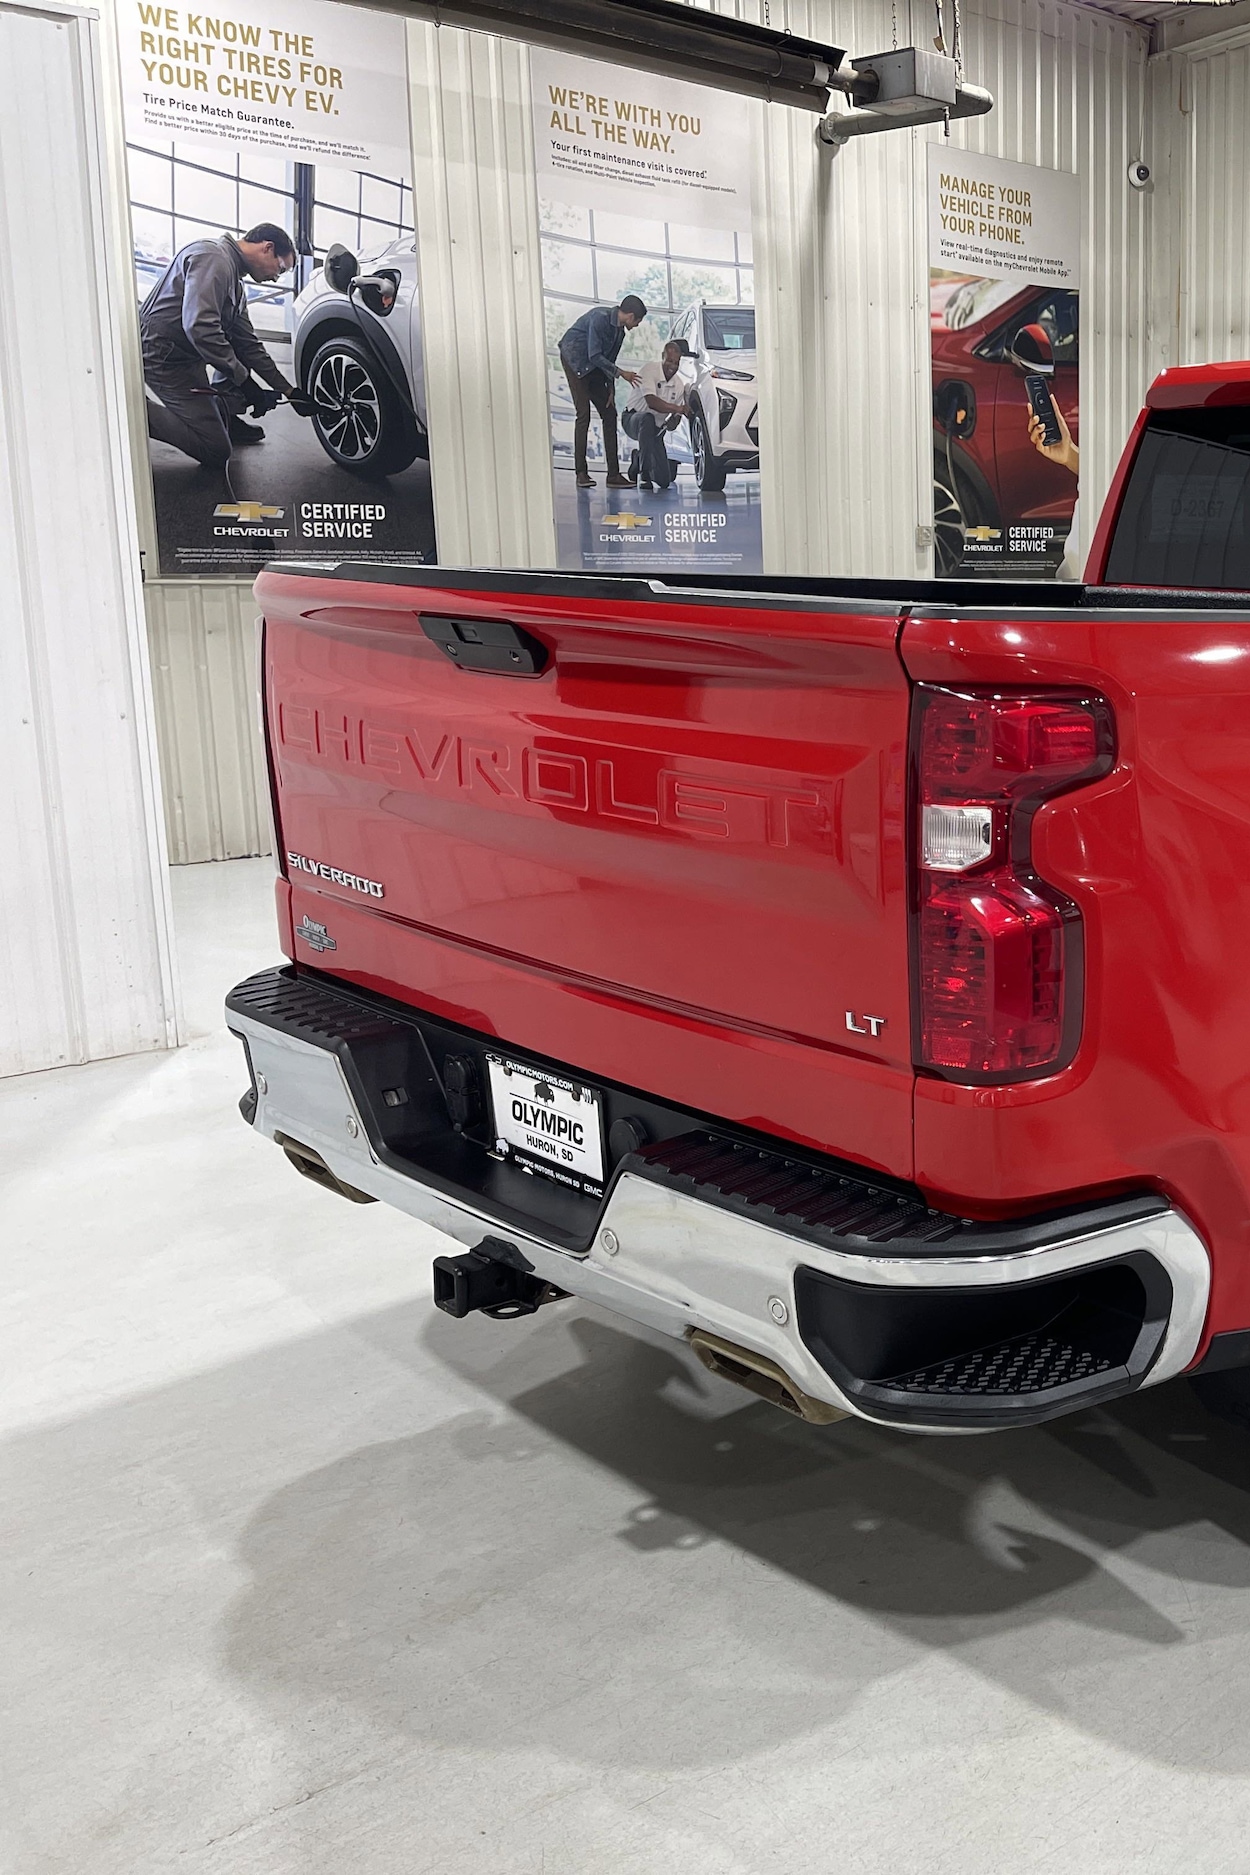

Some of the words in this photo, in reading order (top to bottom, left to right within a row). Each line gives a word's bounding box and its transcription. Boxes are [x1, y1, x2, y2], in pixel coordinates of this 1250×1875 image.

[137, 2, 179, 31] WE
[188, 12, 261, 47] KNOW
[269, 28, 314, 58] THE
[140, 31, 215, 66] RIGHT
[222, 46, 291, 80] TIRES
[299, 61, 344, 90] FOR
[141, 58, 209, 92] YOUR
[216, 73, 298, 108] CHEVY
[305, 90, 340, 115] EV.
[143, 93, 165, 106] Tire
[169, 97, 198, 112] Price
[201, 103, 234, 118] Match
[237, 109, 295, 129] Guarantee.
[548, 85, 609, 116] WE'RE
[614, 99, 661, 127] WITH
[666, 111, 701, 135] YOU
[550, 110, 586, 135] ALL
[591, 119, 627, 144] THE
[632, 128, 675, 154] WAY.
[550, 139, 571, 152] Your
[572, 144, 592, 156] first
[593, 150, 646, 167] maintenance
[647, 159, 665, 171] visit
[666, 163, 673, 172] is
[940, 173, 995, 200] MANAGE
[999, 186, 1031, 207] YOUR
[939, 193, 995, 220] VEHICLE
[999, 206, 1032, 227] FROM
[940, 213, 975, 235] YOUR
[979, 221, 1025, 245] PHONE.
[940, 238, 954, 247] View
[956, 242, 983, 252] real-time
[984, 246, 1016, 258] diagnostics
[1028, 255, 1043, 265] enjoy
[1044, 258, 1063, 267] remote
[958, 253, 984, 262] available
[993, 257, 1002, 265] the
[1004, 260, 1038, 271] myChevrolet
[1040, 264, 1056, 274] Mobile
[300, 502, 386, 520] CERTIFIED
[664, 513, 726, 528] CERTIFIED
[213, 526, 290, 538] CHEVROLET
[302, 522, 373, 538] SERVICE
[600, 534, 656, 542] CHEVROLET
[665, 529, 717, 543] SERVICE
[1009, 527, 1054, 539] CERTIFIED
[964, 544, 1003, 552] CHEVROLET
[1010, 540, 1046, 552] SERVICE
[280, 702, 819, 847] CHEVROLET
[288, 851, 384, 898] SILVERADO
[845, 1010, 886, 1038] LT
[506, 1060, 574, 1090] OLYMPICMOTORS.COM
[512, 1100, 584, 1145] OLYMPIC
[526, 1134, 559, 1159] HURON,
[562, 1148, 574, 1162] SD
[583, 1183, 603, 1198] GMC
